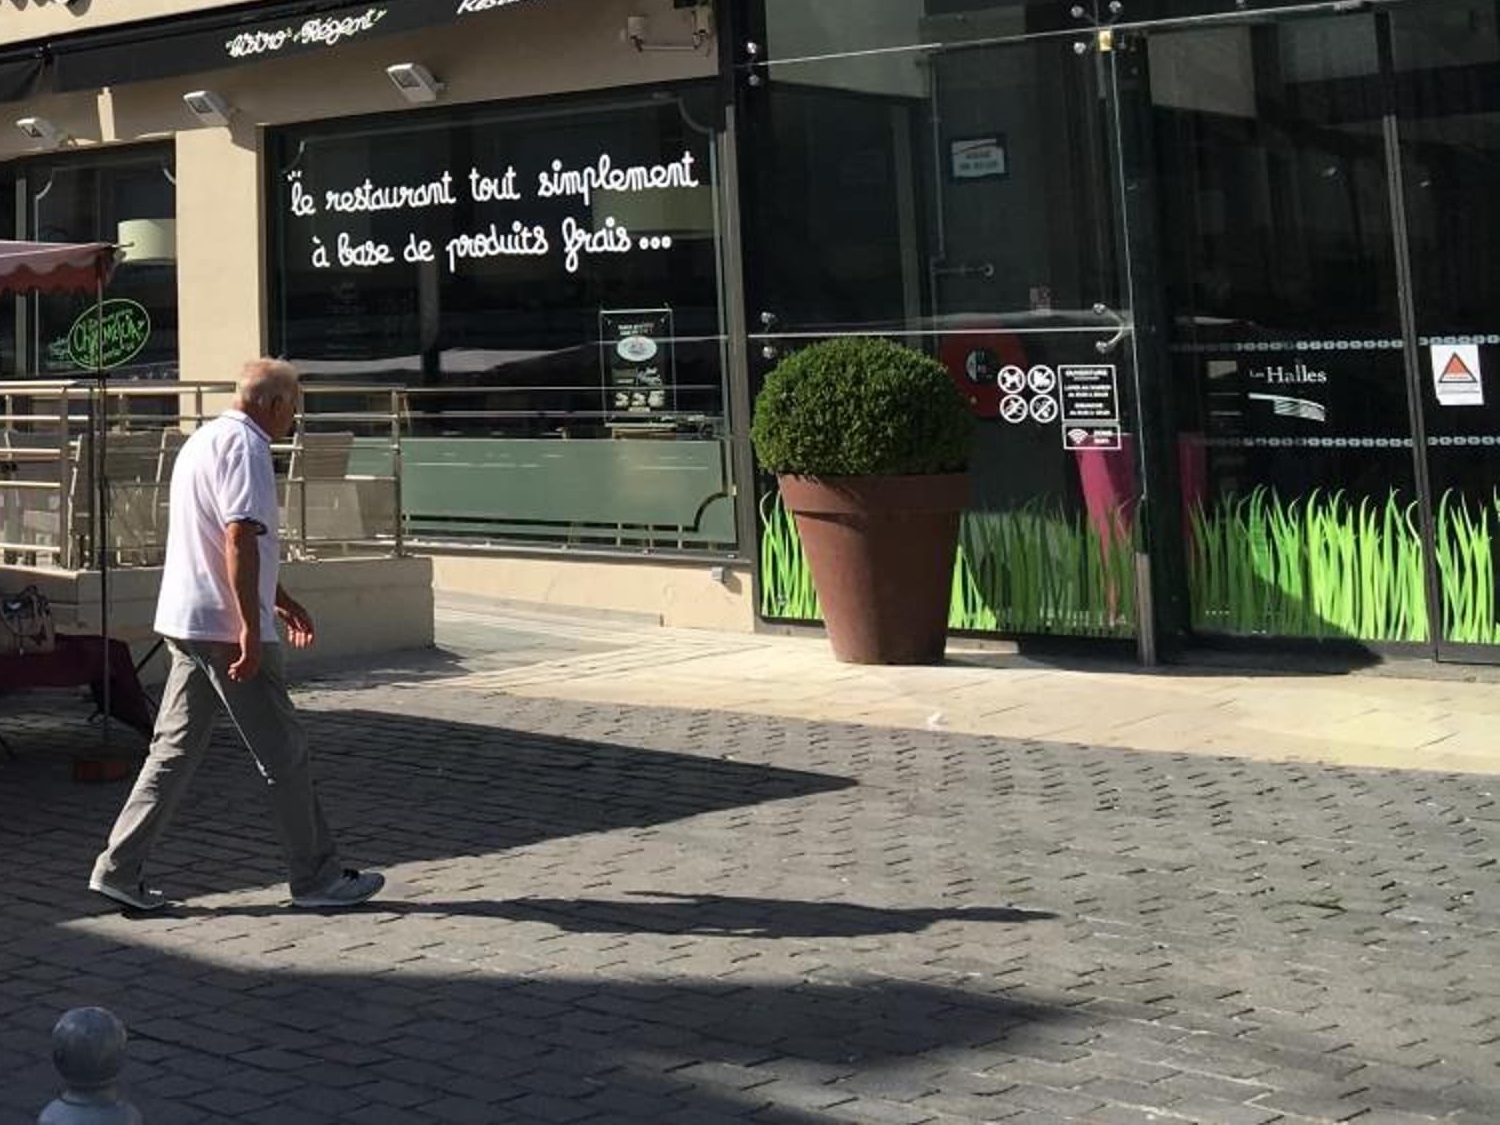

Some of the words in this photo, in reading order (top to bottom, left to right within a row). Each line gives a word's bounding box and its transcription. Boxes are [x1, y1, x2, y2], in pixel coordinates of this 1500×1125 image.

[325, 170, 457, 213] restaurant
[468, 166, 521, 203] tout
[537, 151, 700, 206] simplement
[310, 236, 331, 269] à
[337, 232, 395, 267] base
[403, 232, 436, 263] de
[445, 221, 549, 272] produits
[1266, 364, 1328, 384] Halles
